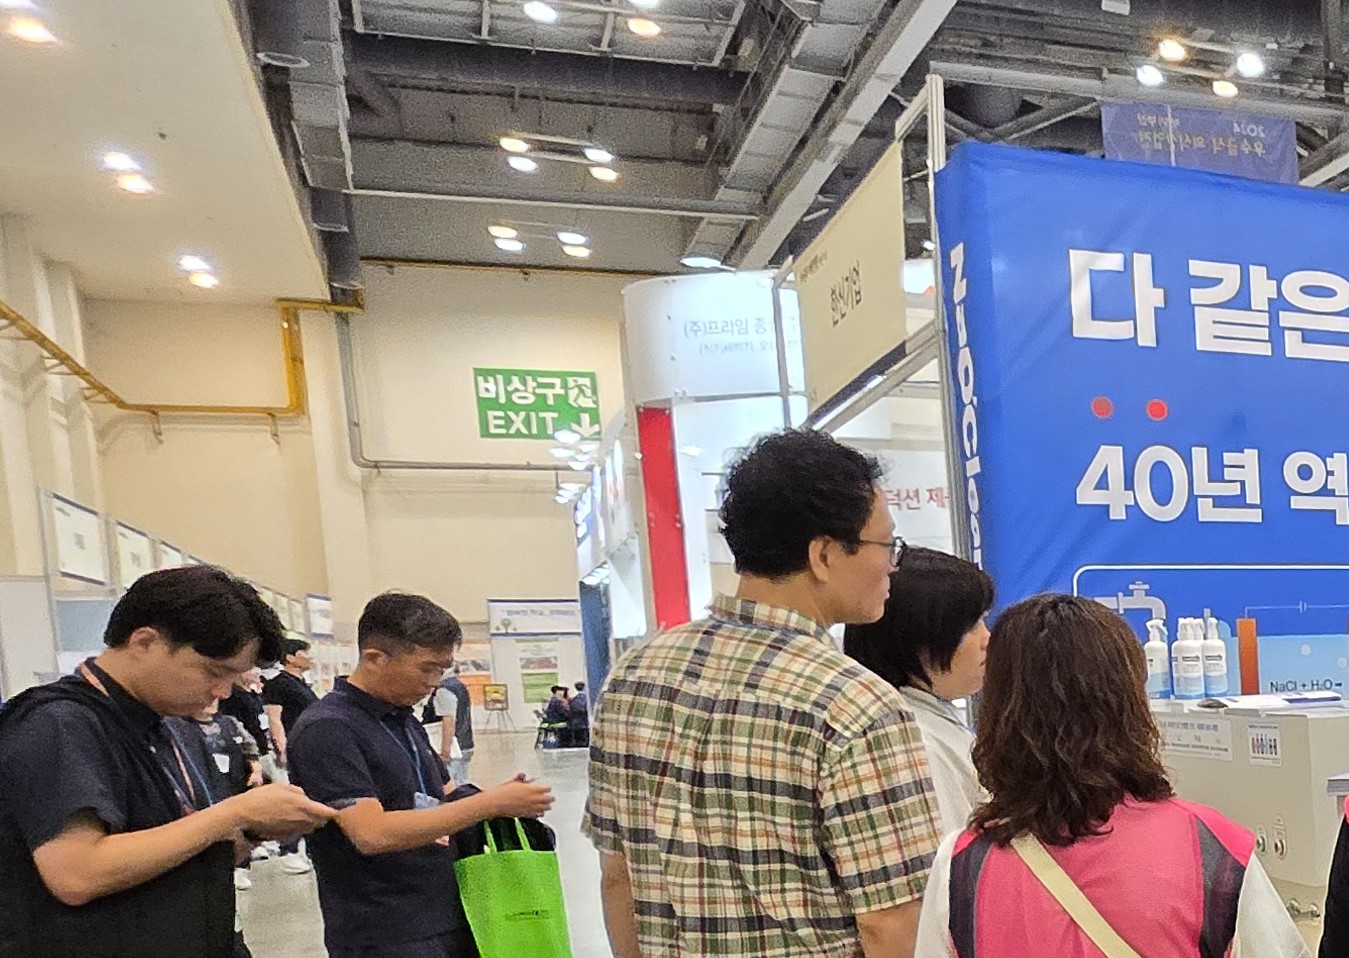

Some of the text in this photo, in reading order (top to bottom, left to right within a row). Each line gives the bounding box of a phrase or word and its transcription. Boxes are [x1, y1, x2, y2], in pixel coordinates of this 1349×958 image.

[1067, 249, 1166, 347] 다
[477, 374, 566, 406] 비상구
[487, 411, 558, 436] EXIT
[1076, 444, 1262, 525] 40년
[885, 487, 950, 511] 덕션 제
[1270, 679, 1298, 692] NaCl
